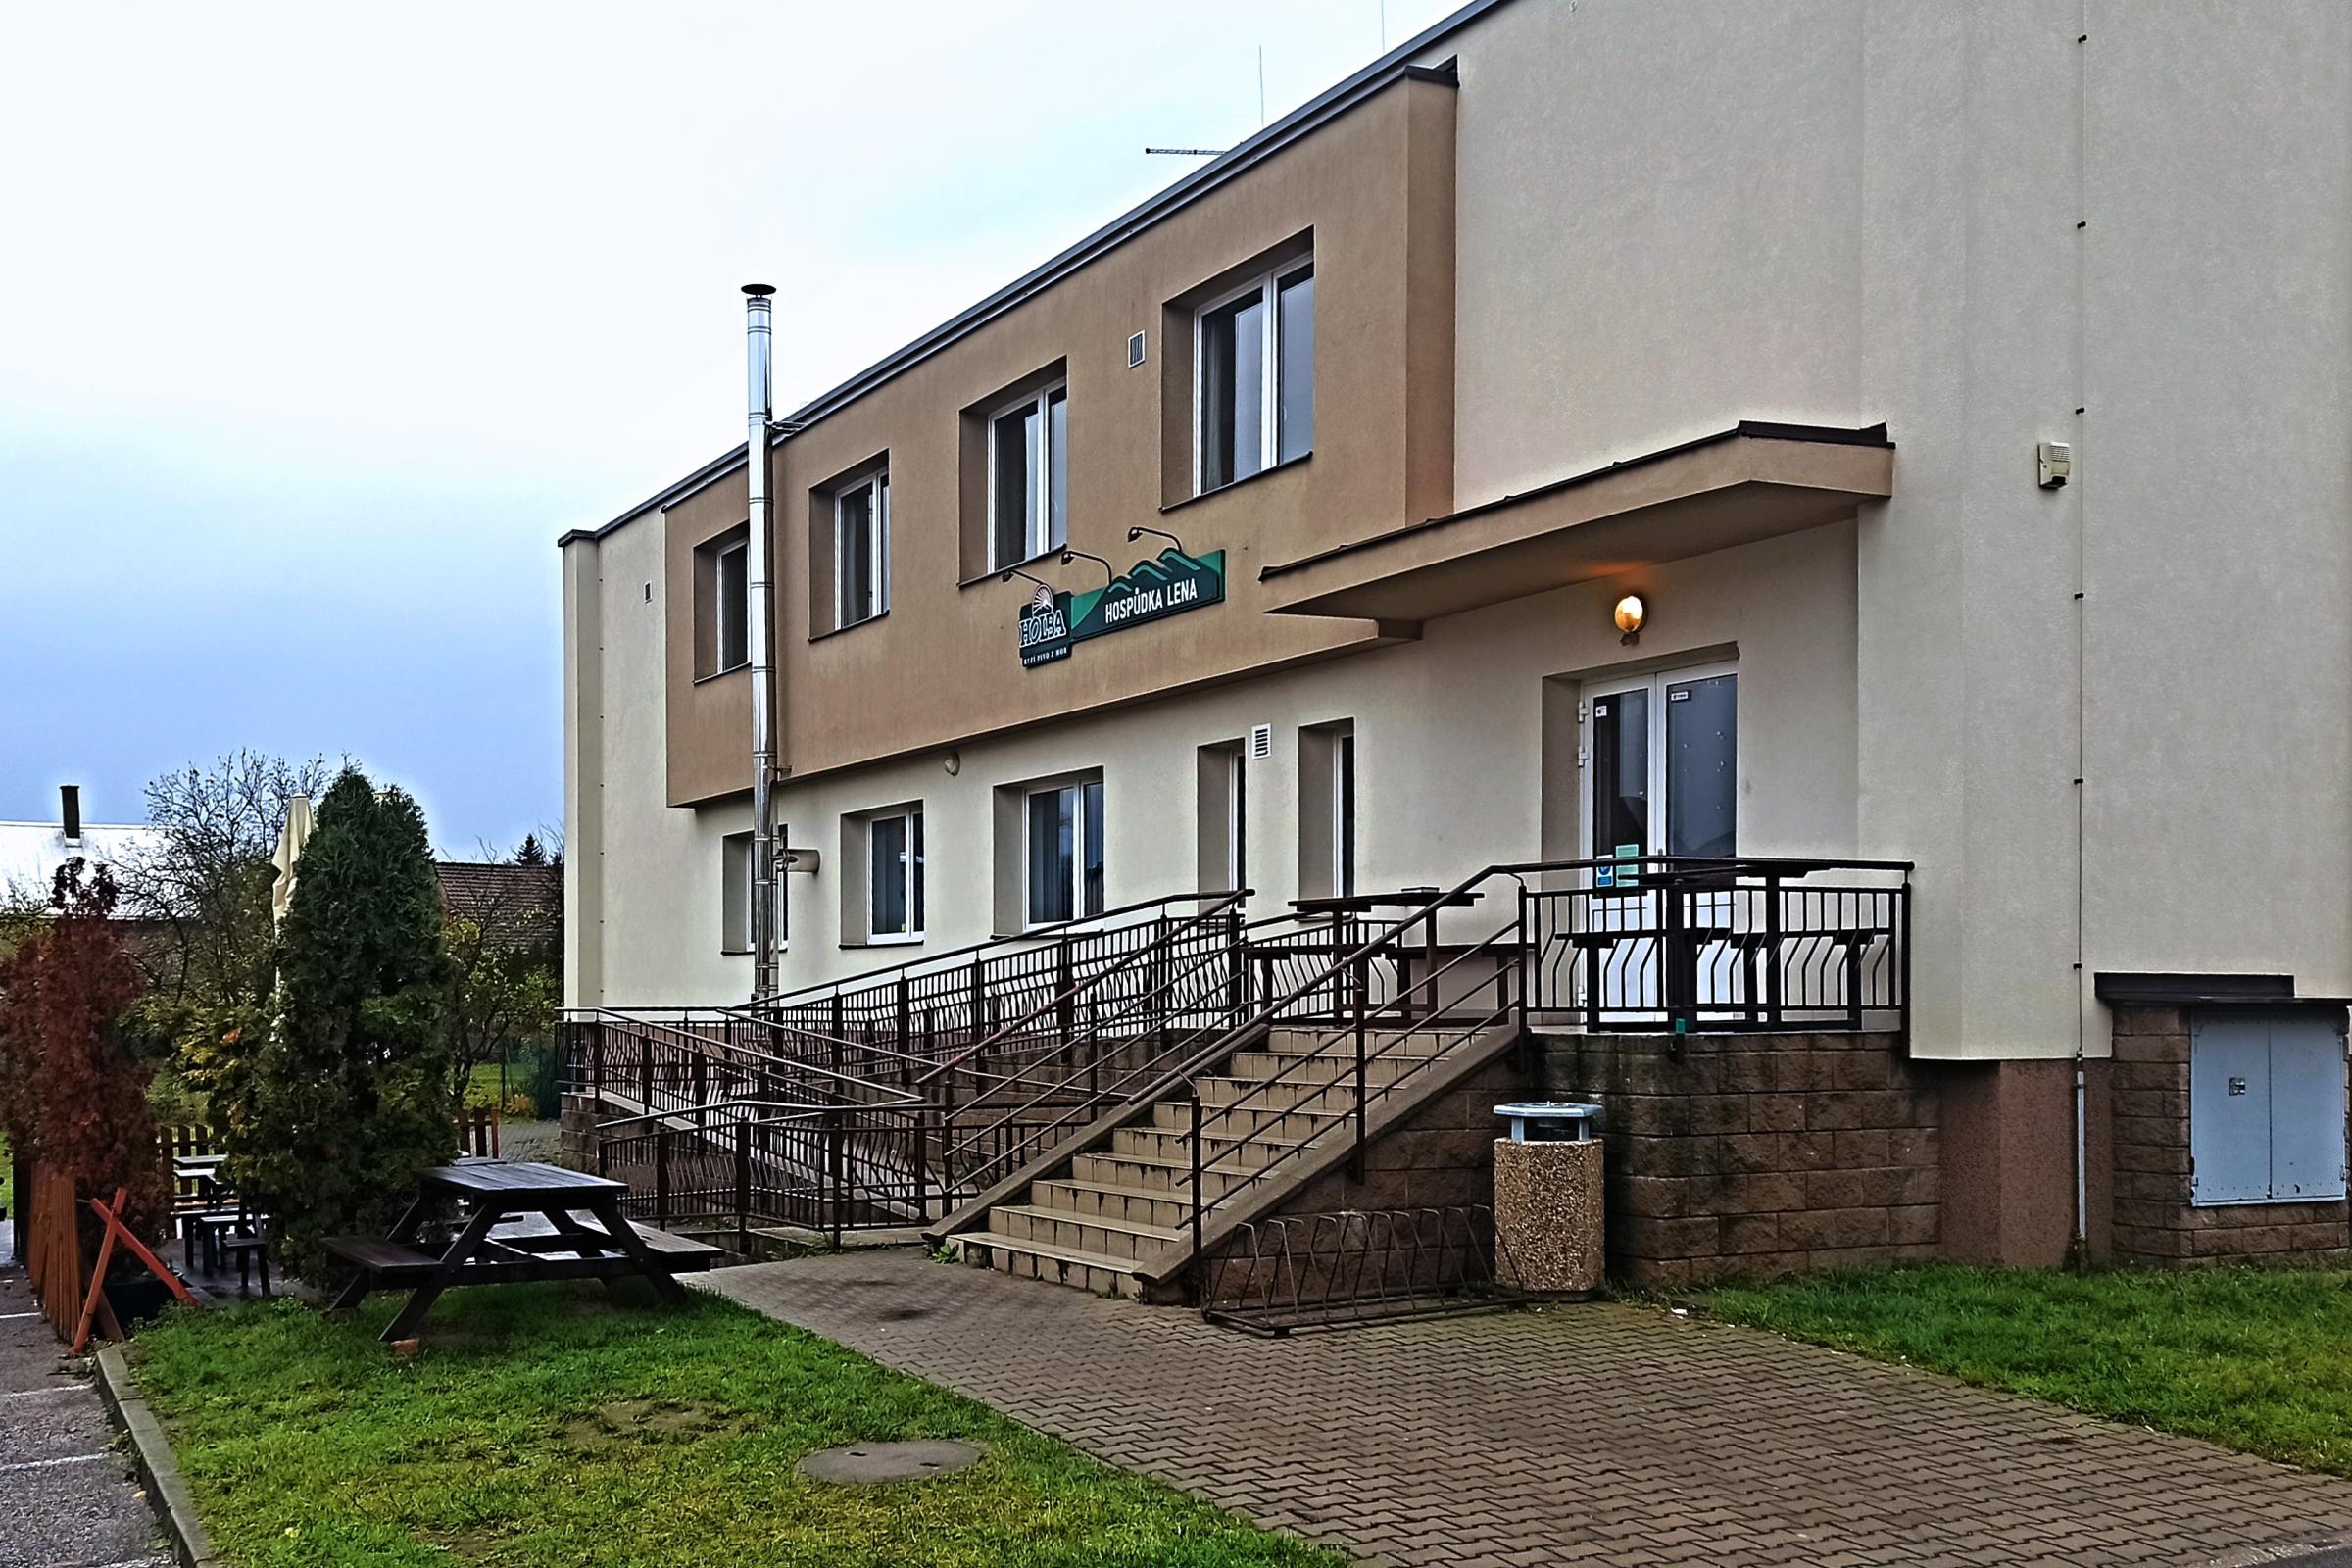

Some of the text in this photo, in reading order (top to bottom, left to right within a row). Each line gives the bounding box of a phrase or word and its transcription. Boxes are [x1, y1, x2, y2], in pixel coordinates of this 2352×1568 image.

[1105, 578, 1198, 624] HOSPŮDKA LENA
[1019, 610, 1066, 648] HOLBA
